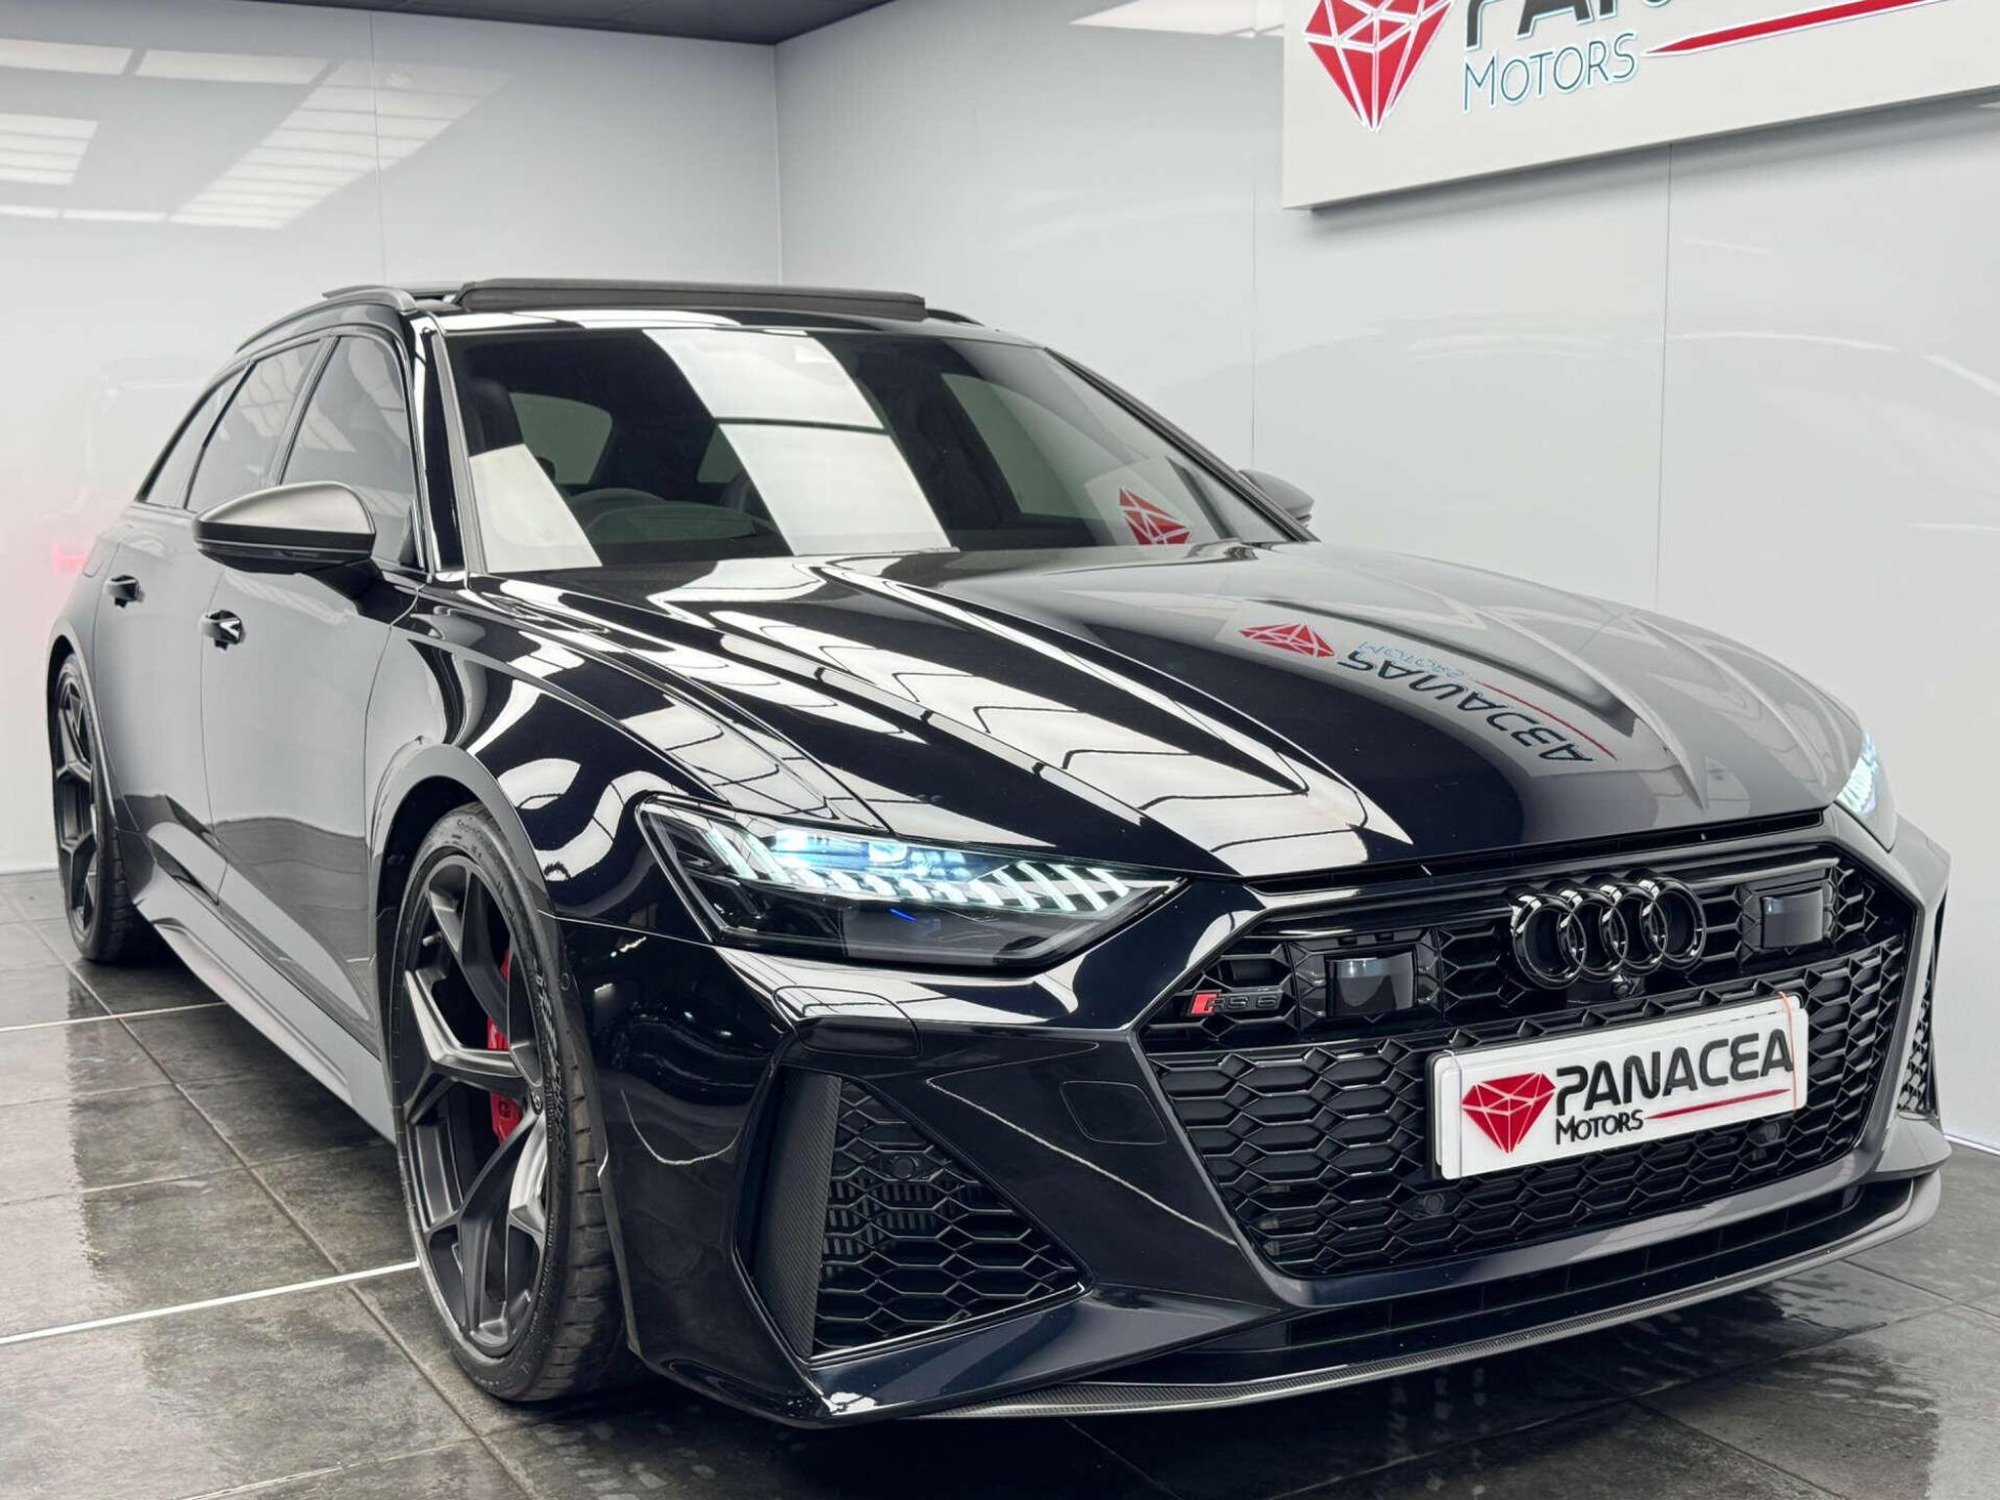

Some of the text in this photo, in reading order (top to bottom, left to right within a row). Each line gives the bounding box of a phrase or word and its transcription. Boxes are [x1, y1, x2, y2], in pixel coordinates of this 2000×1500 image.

[1463, 32, 1637, 112] MOTORS
[1555, 1028, 1795, 1116] PANACEA
[1555, 1108, 1644, 1146] MOTORS
